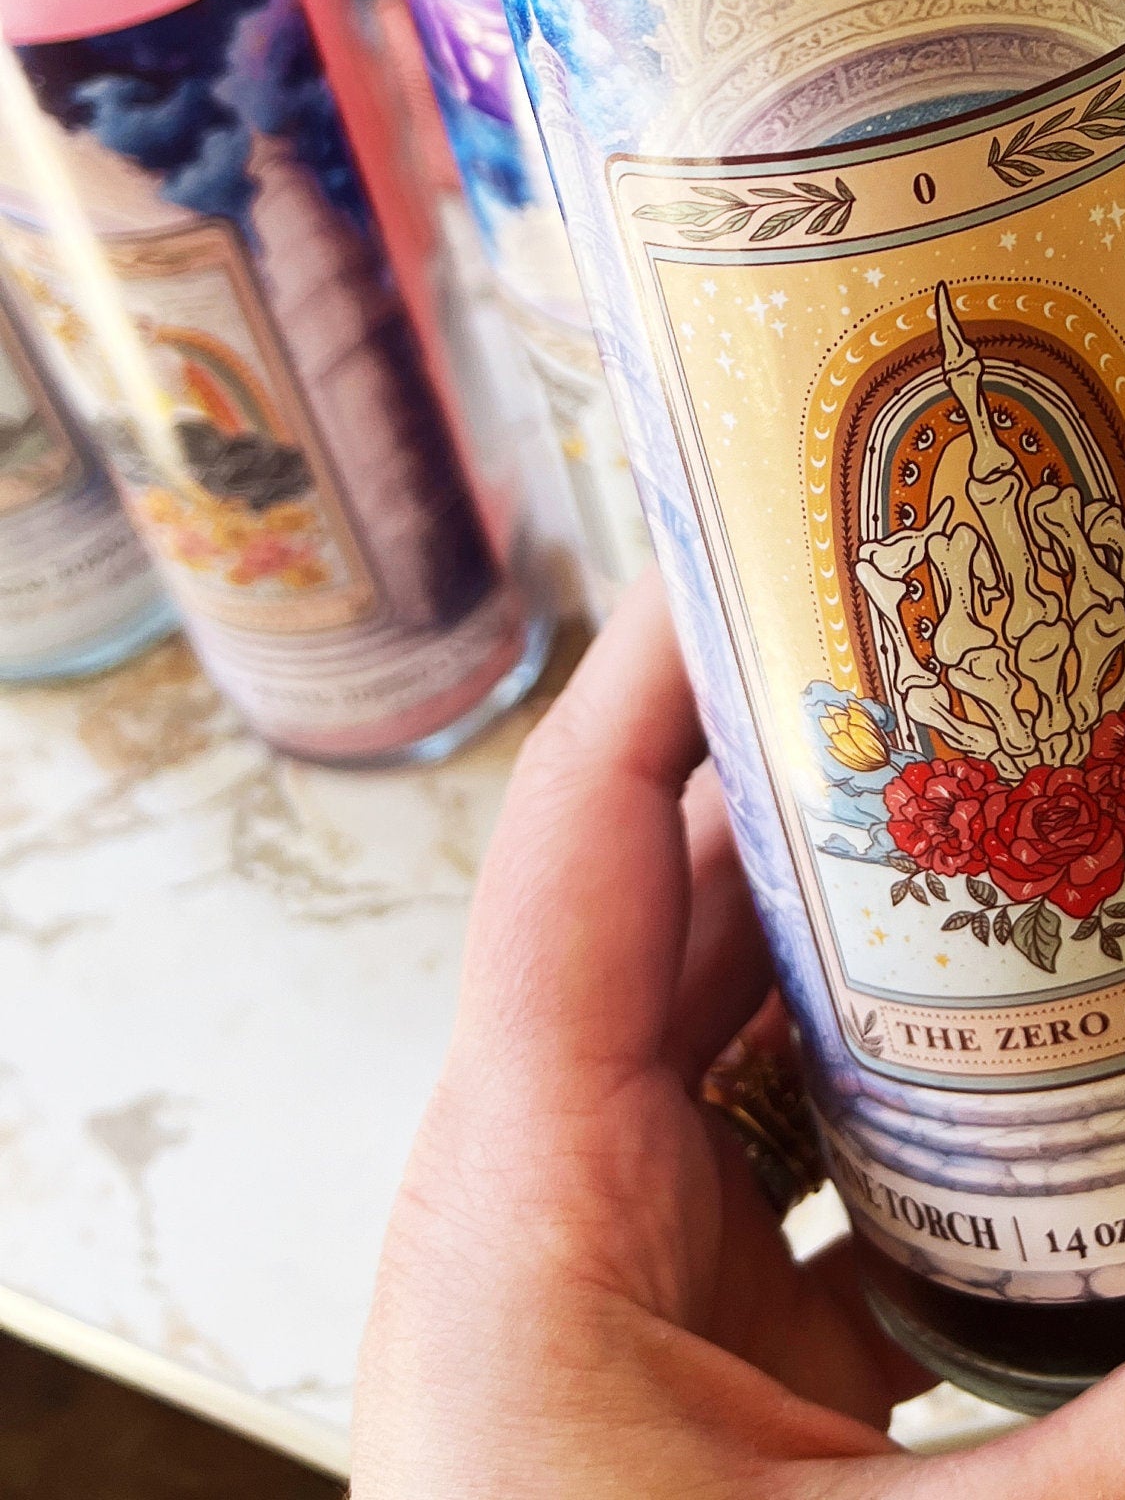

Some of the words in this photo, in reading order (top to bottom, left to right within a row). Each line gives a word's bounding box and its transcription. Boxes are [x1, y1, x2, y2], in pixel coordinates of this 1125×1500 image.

[895, 1020, 982, 1052] THE
[996, 1011, 1110, 1052] ZERO
[879, 1182, 1001, 1250] TORCH
[1045, 1227, 1088, 1259] 14
